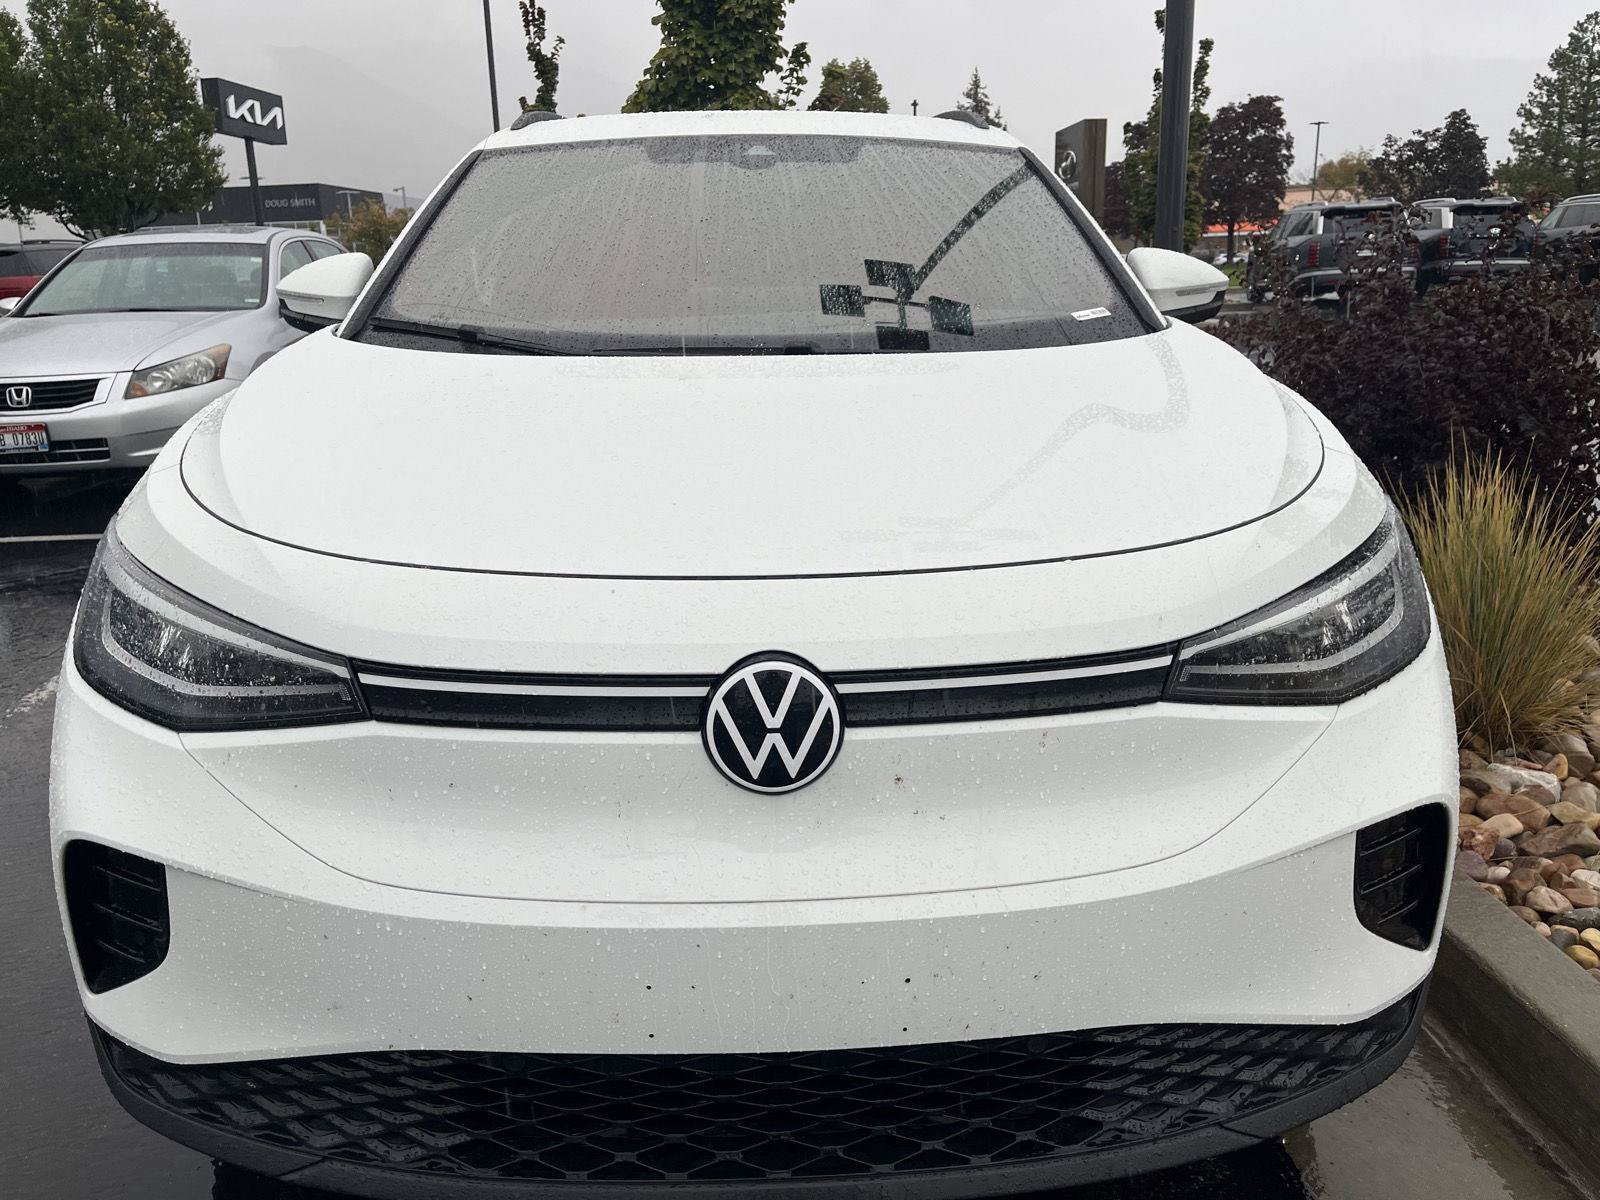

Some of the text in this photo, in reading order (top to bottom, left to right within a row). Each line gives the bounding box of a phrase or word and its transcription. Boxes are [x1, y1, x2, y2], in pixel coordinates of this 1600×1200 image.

[226, 94, 284, 130] KIA
[264, 198, 316, 208] DOUG SMITH
